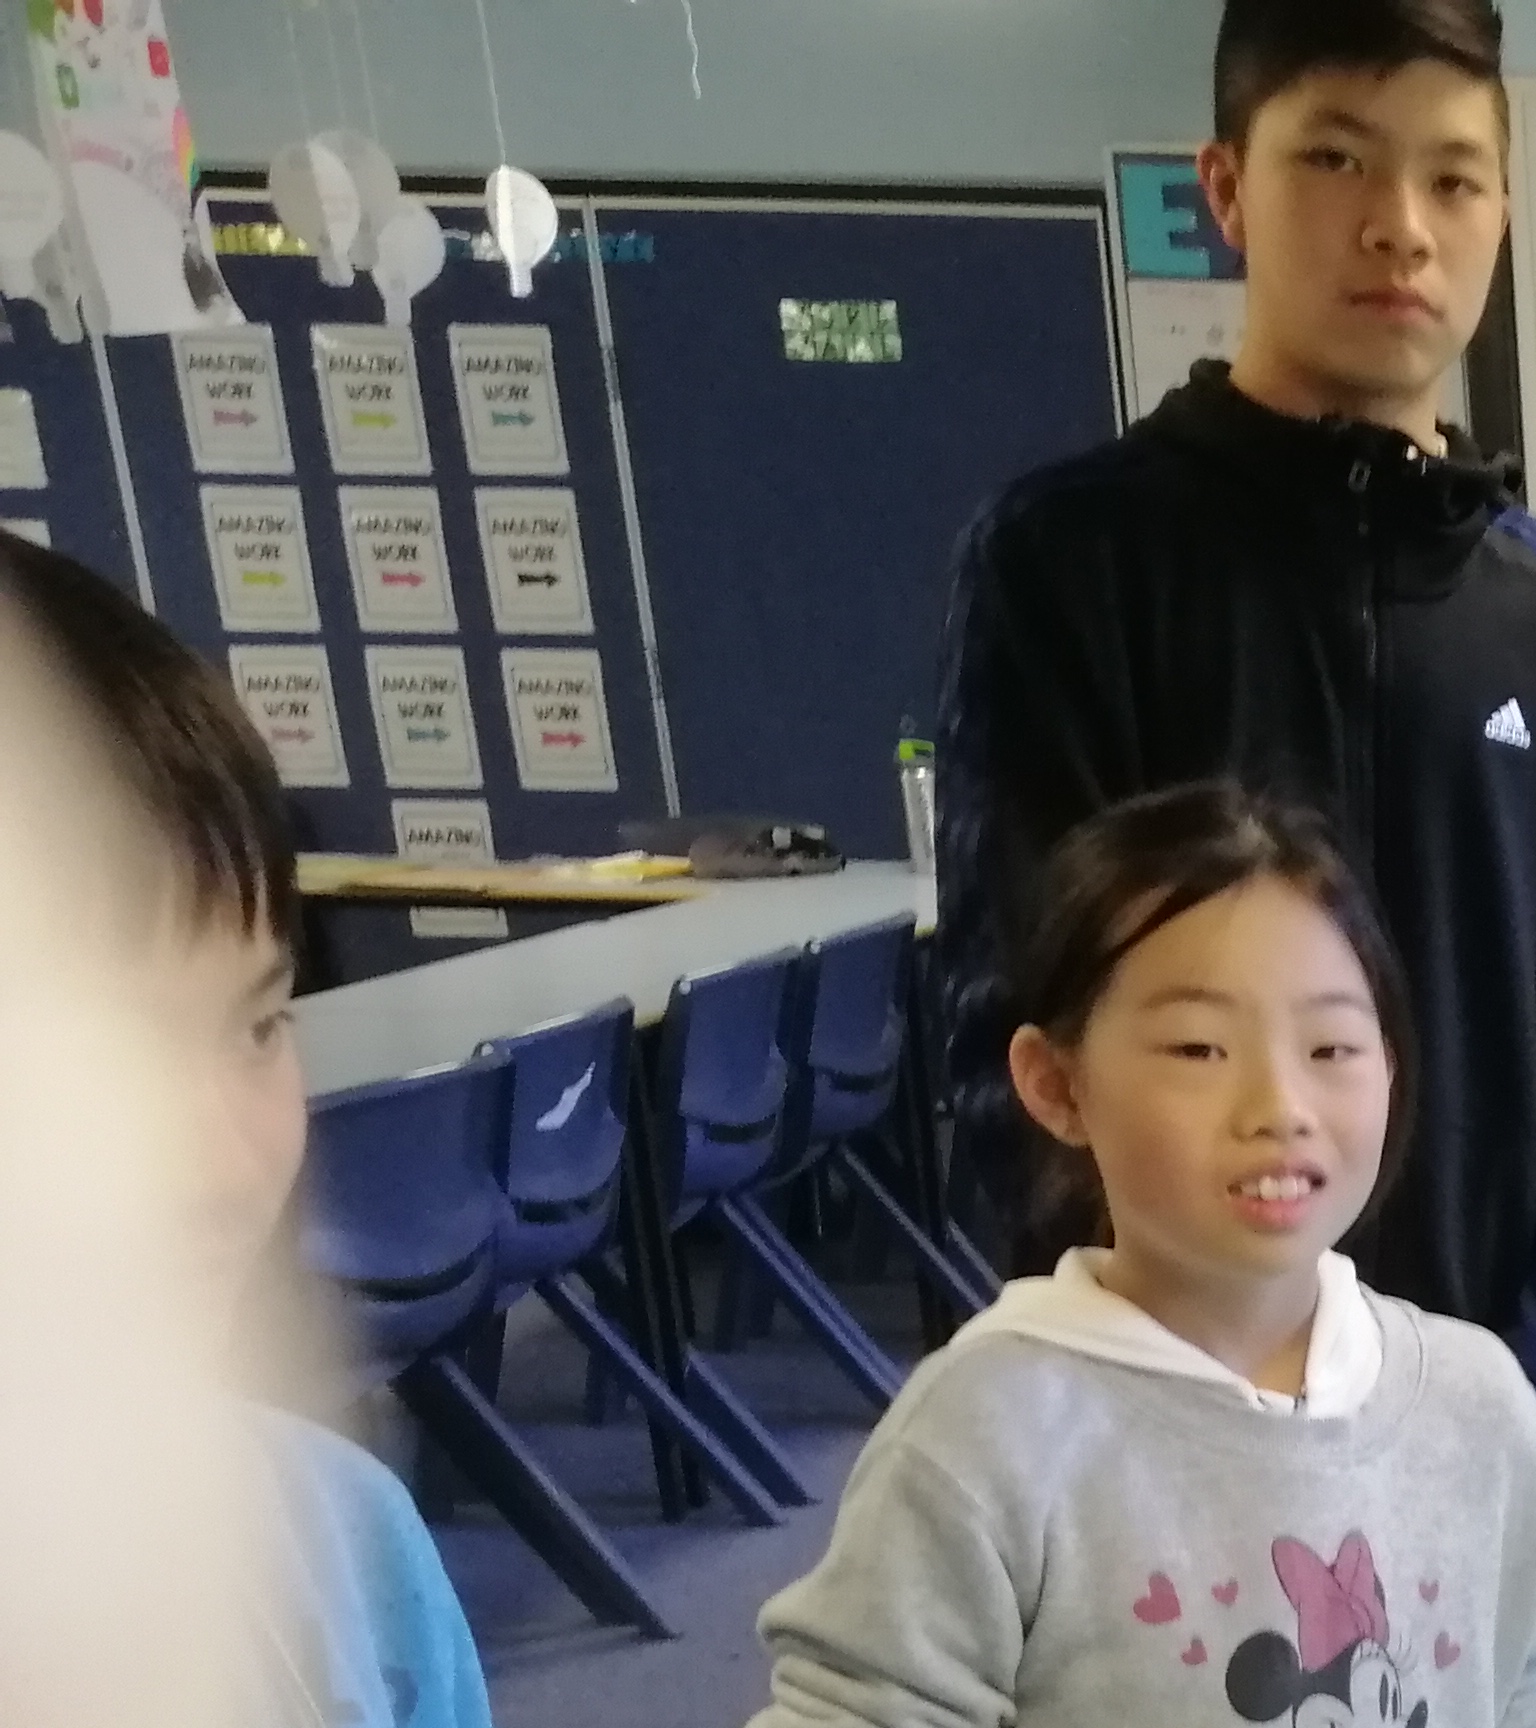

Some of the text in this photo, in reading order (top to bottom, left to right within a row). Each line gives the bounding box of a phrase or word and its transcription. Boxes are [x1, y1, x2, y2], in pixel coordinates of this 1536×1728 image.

[205, 382, 254, 400] WORK
[345, 383, 396, 401] WORK
[483, 384, 531, 401] WORK
[233, 542, 283, 561] WORK
[371, 543, 419, 562] WORK
[508, 544, 557, 562] WORK
[262, 702, 310, 719] WORK
[397, 703, 446, 720] WORK
[532, 704, 582, 722] WORK
